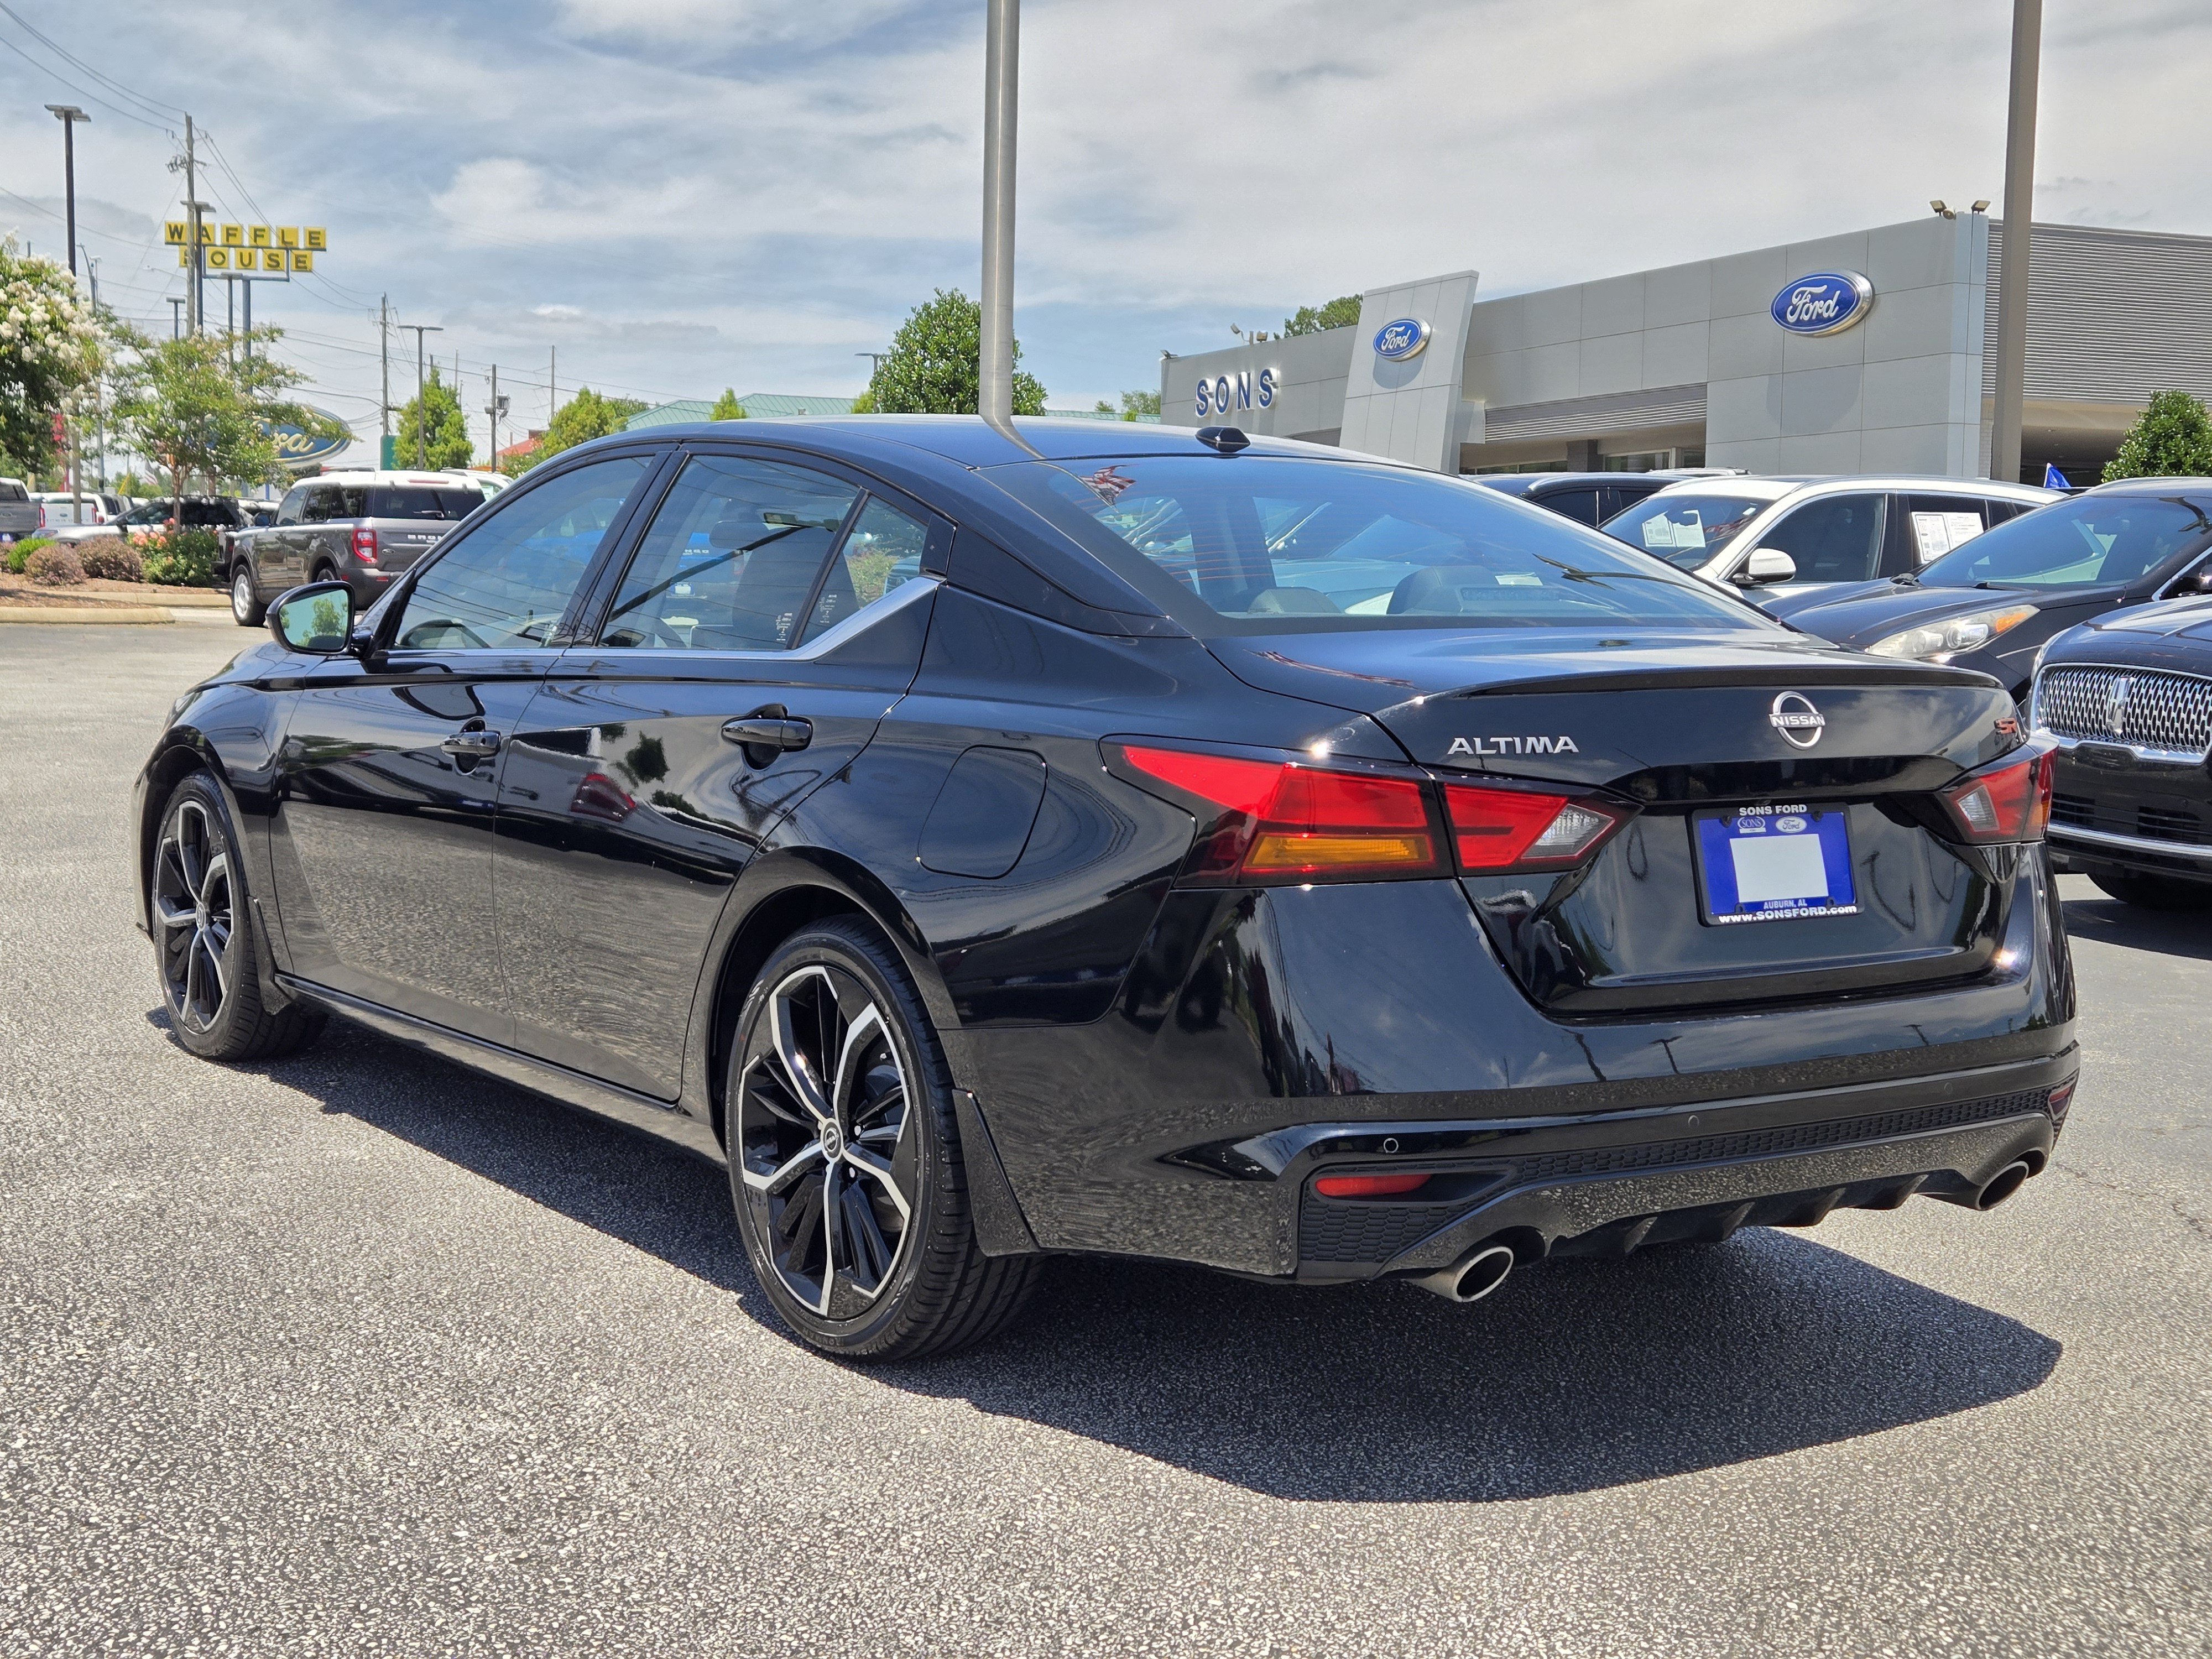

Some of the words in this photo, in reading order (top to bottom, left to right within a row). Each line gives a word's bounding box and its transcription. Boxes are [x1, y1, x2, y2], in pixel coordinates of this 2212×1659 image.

[168, 223, 321, 246] WAFFLE
[183, 249, 308, 270] OUSE
[1787, 285, 1841, 323] Ford
[1381, 326, 1412, 351] Ford
[1195, 368, 1277, 418] SONS
[1771, 716, 1825, 726] NISSAN
[1994, 717, 2017, 735] SR
[1447, 736, 1579, 755] ALTIMA
[1739, 806, 1772, 816] SONS
[1775, 804, 1807, 814] FORD
[1741, 818, 1762, 828] SONS
[1782, 819, 1801, 830] Ford
[1798, 899, 1808, 907] AL
[1718, 905, 1858, 924] www.SONSFORD.com
